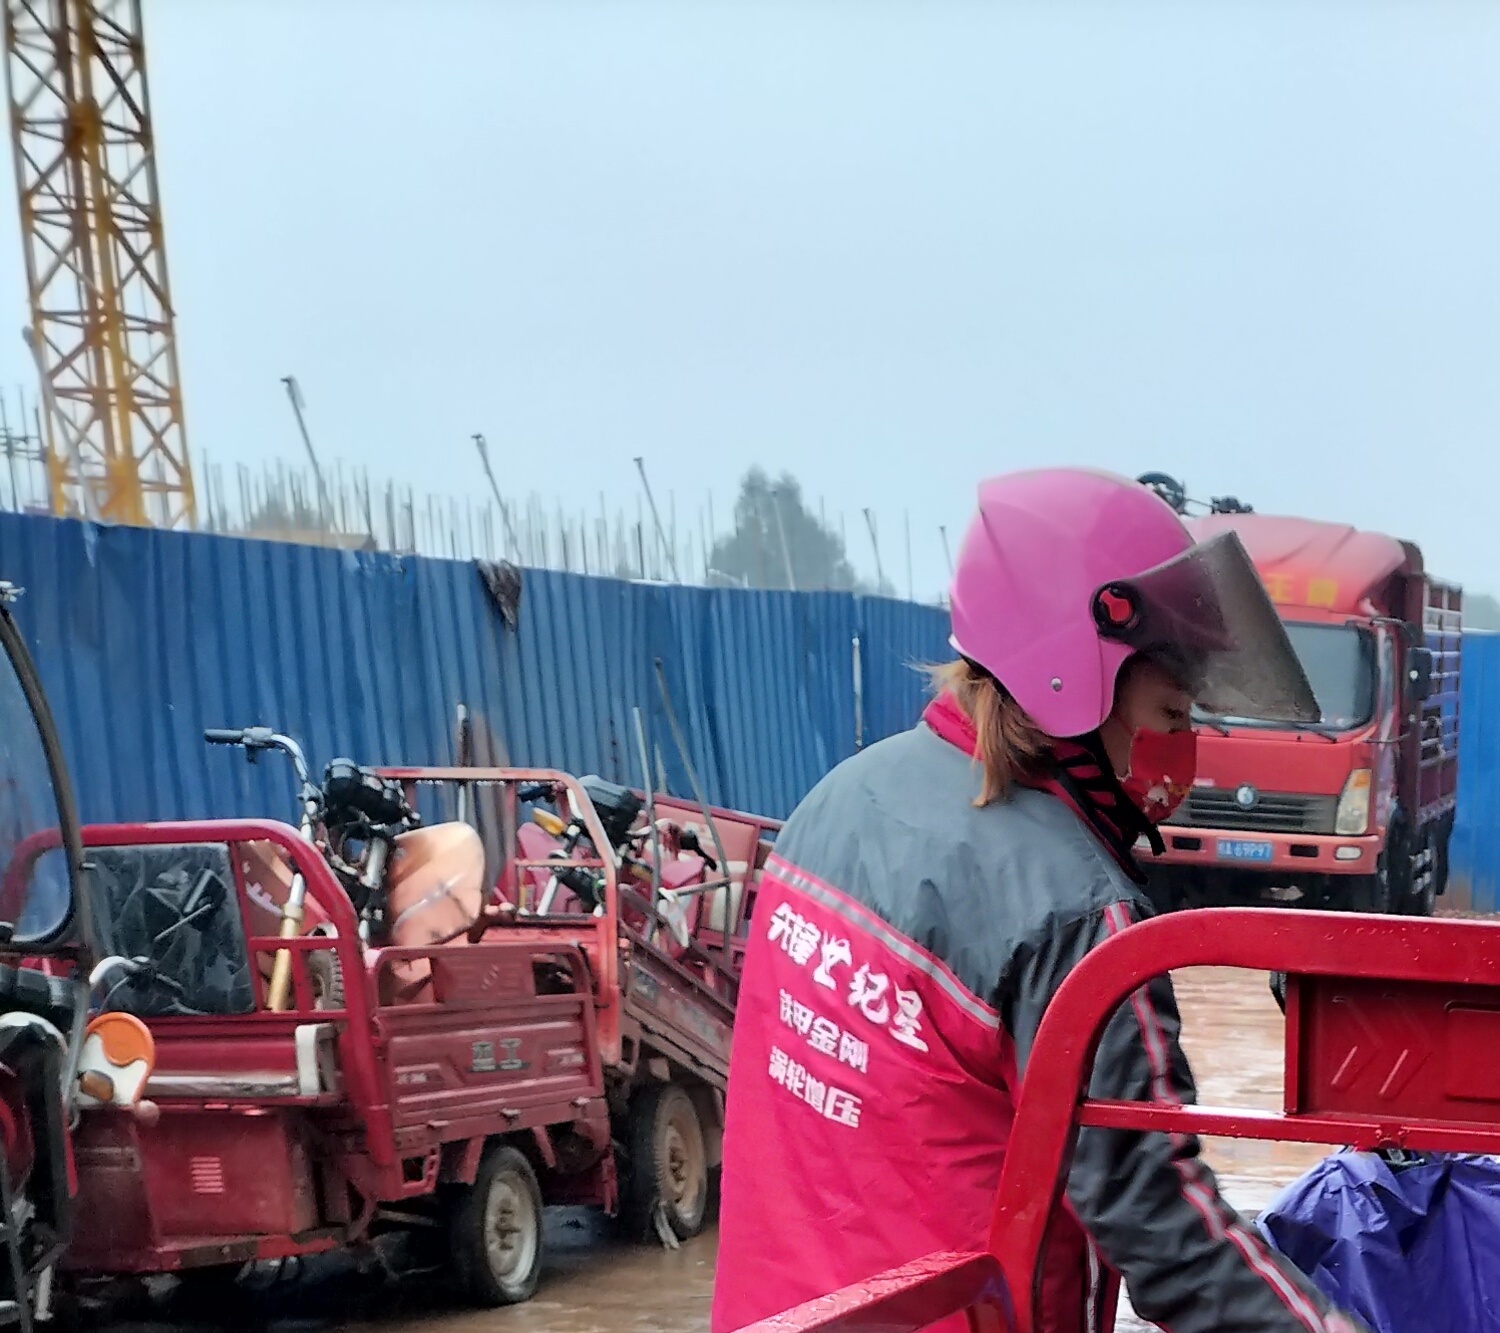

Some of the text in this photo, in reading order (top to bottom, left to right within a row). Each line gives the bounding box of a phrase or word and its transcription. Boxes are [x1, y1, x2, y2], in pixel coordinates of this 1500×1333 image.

[779, 988, 869, 1074] 铁甲金刚
[768, 1045, 862, 1129] 涡轮增压
